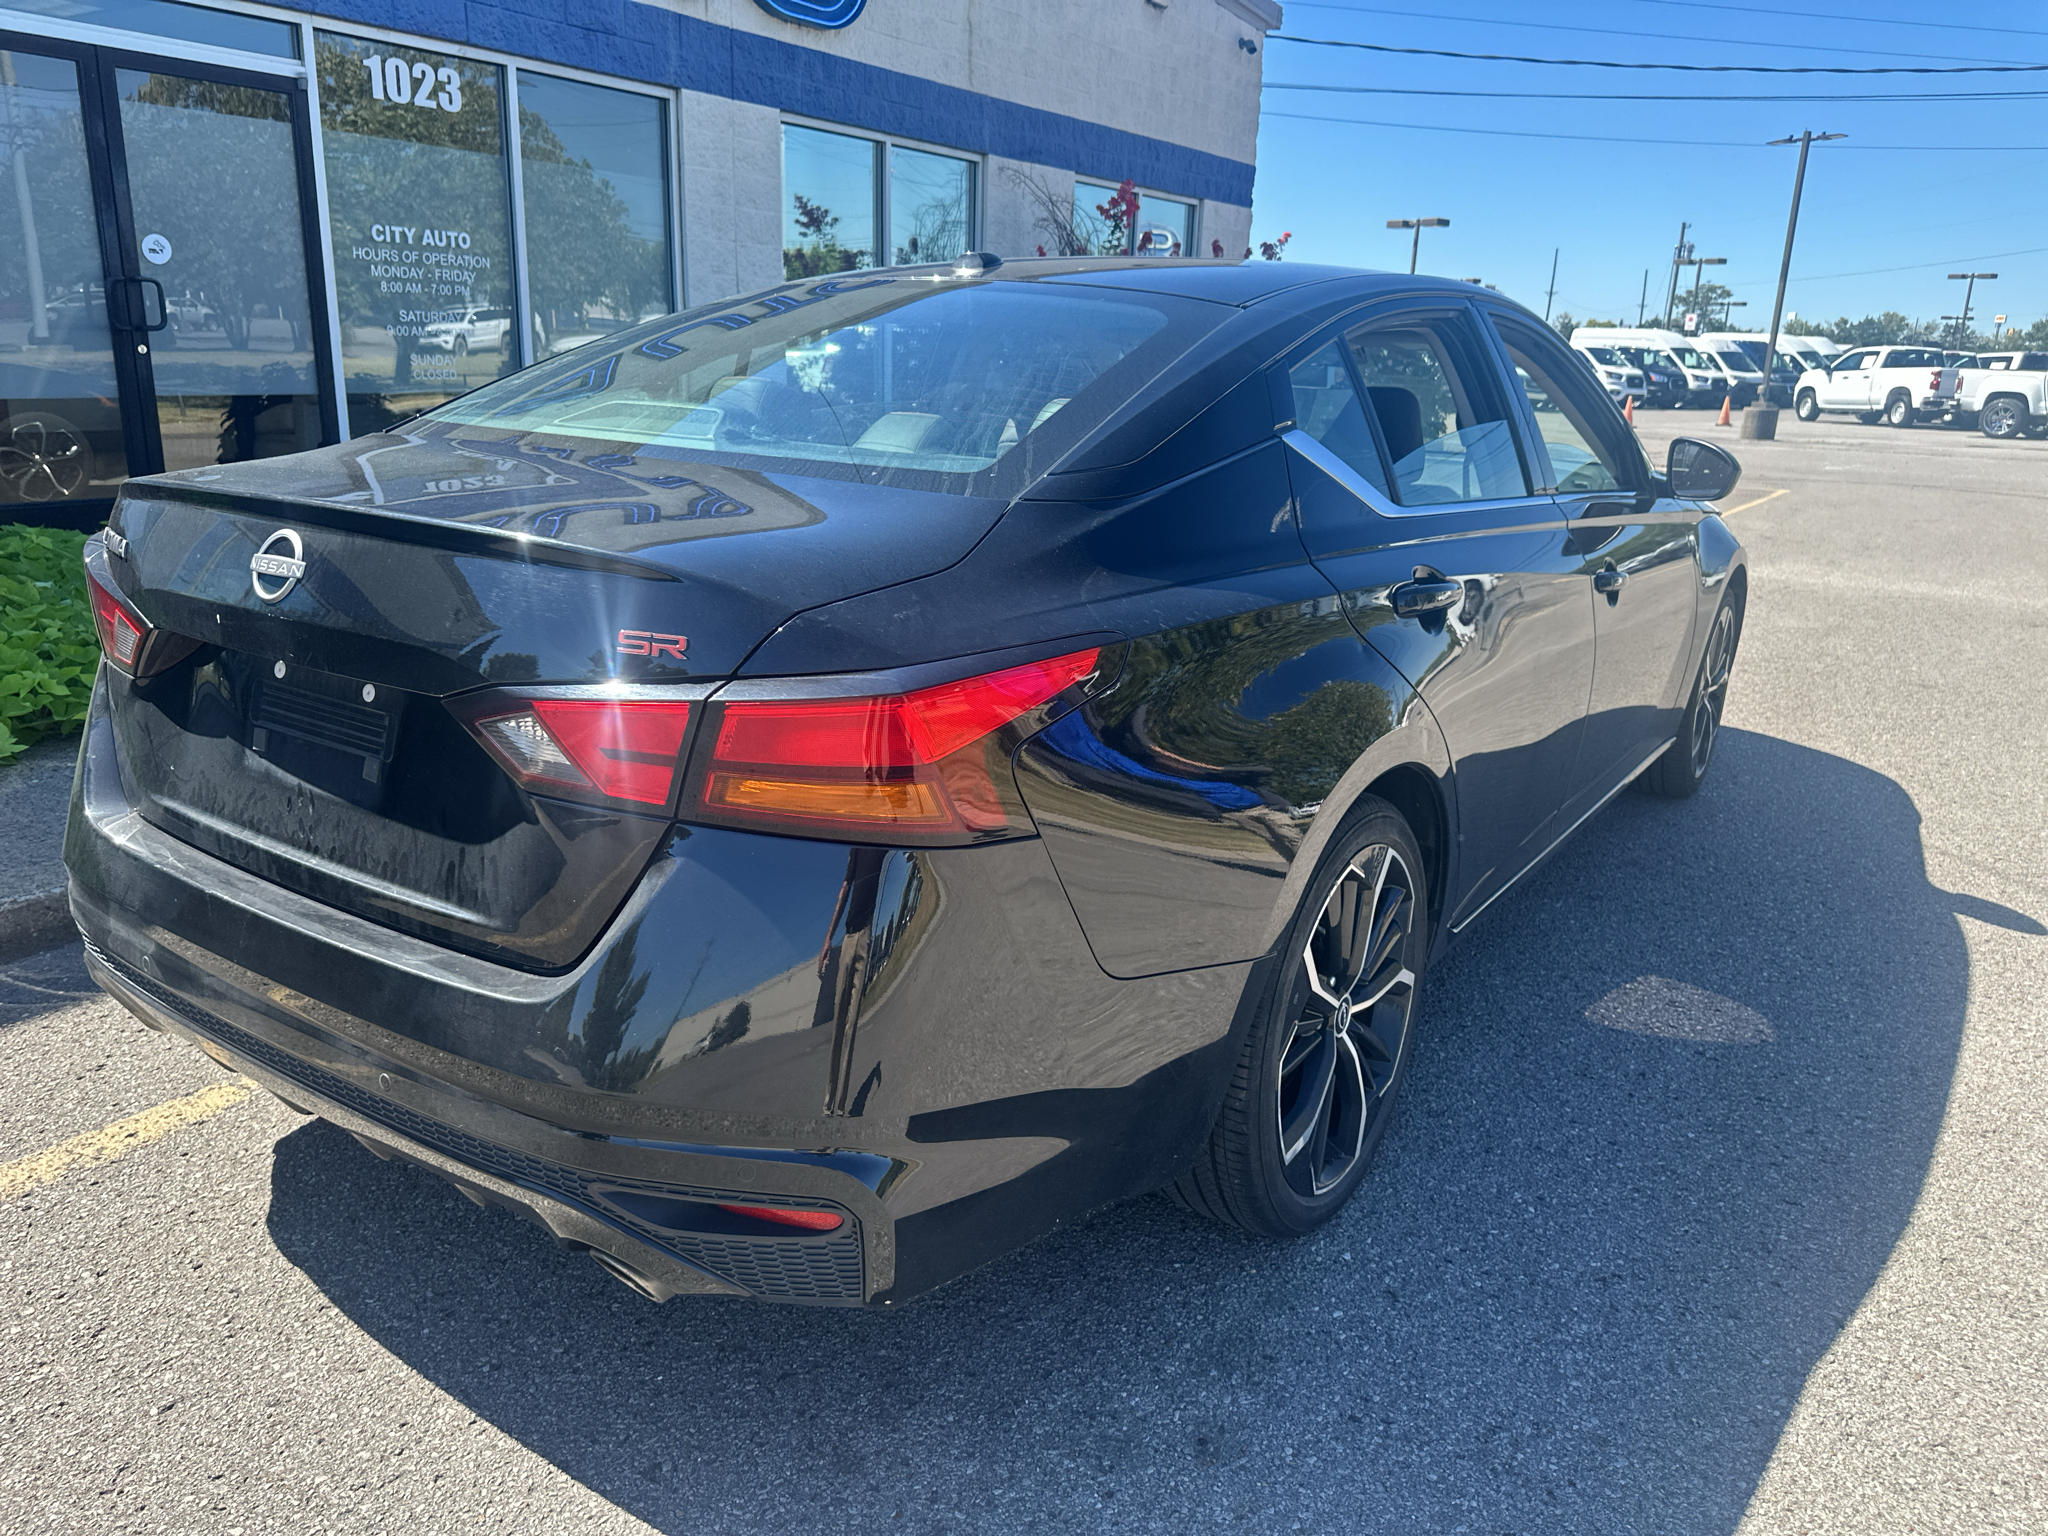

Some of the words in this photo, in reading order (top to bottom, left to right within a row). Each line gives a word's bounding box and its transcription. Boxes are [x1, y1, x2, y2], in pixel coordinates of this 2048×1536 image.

[362, 54, 463, 113] 1023
[371, 223, 416, 245] CITY
[422, 228, 471, 250] AUTO
[352, 246, 399, 263] HOURS
[402, 250, 419, 264] OF
[422, 252, 490, 269] OPERATION
[370, 264, 424, 280] MONDAY
[434, 269, 476, 283] FRIDAY
[380, 281, 403, 294] 8:00
[405, 283, 422, 294] AM
[431, 284, 451, 296] 7:00
[454, 285, 470, 297] PM
[399, 309, 463, 324] SATURDAY
[411, 327, 428, 337] AM
[409, 353, 457, 366] SUNDAY
[412, 369, 458, 381] CLOSED
[251, 556, 304, 577] NISSAN
[616, 629, 688, 660] SR
